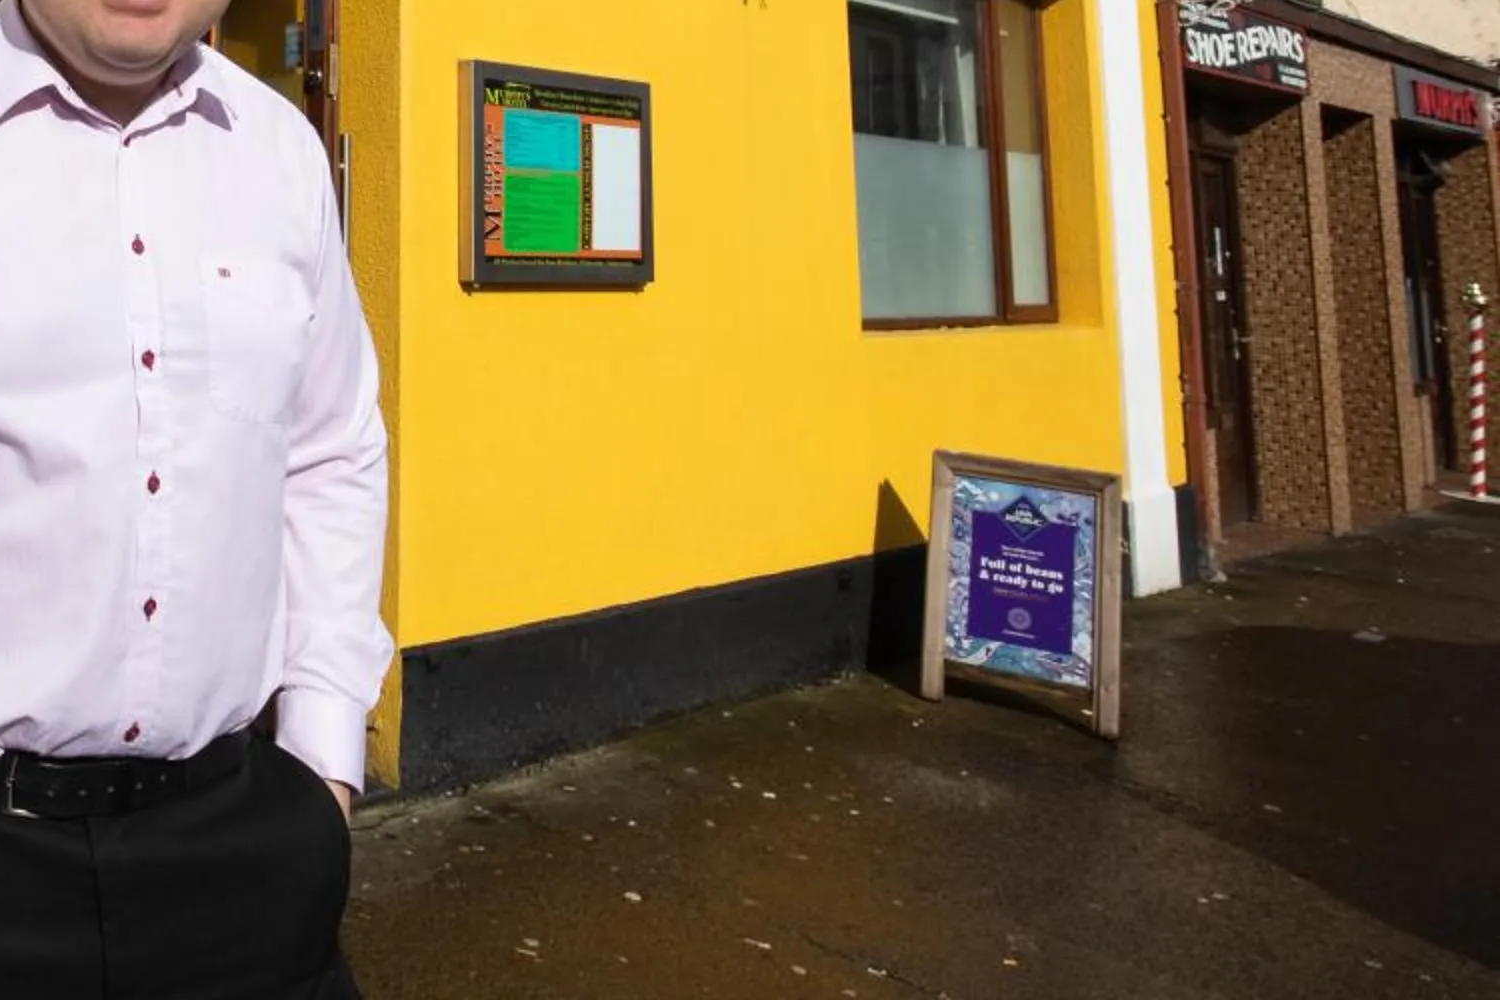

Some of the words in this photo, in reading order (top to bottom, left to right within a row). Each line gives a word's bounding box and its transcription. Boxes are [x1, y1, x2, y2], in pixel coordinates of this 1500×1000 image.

[1186, 28, 1238, 66] SHOE
[1236, 25, 1304, 63] REPAIRS
[981, 557, 1006, 571] Full
[1009, 563, 1022, 573] of
[1026, 565, 1063, 580] beans
[993, 573, 1028, 588] ready
[1031, 579, 1045, 590] to
[1048, 583, 1063, 595] go
